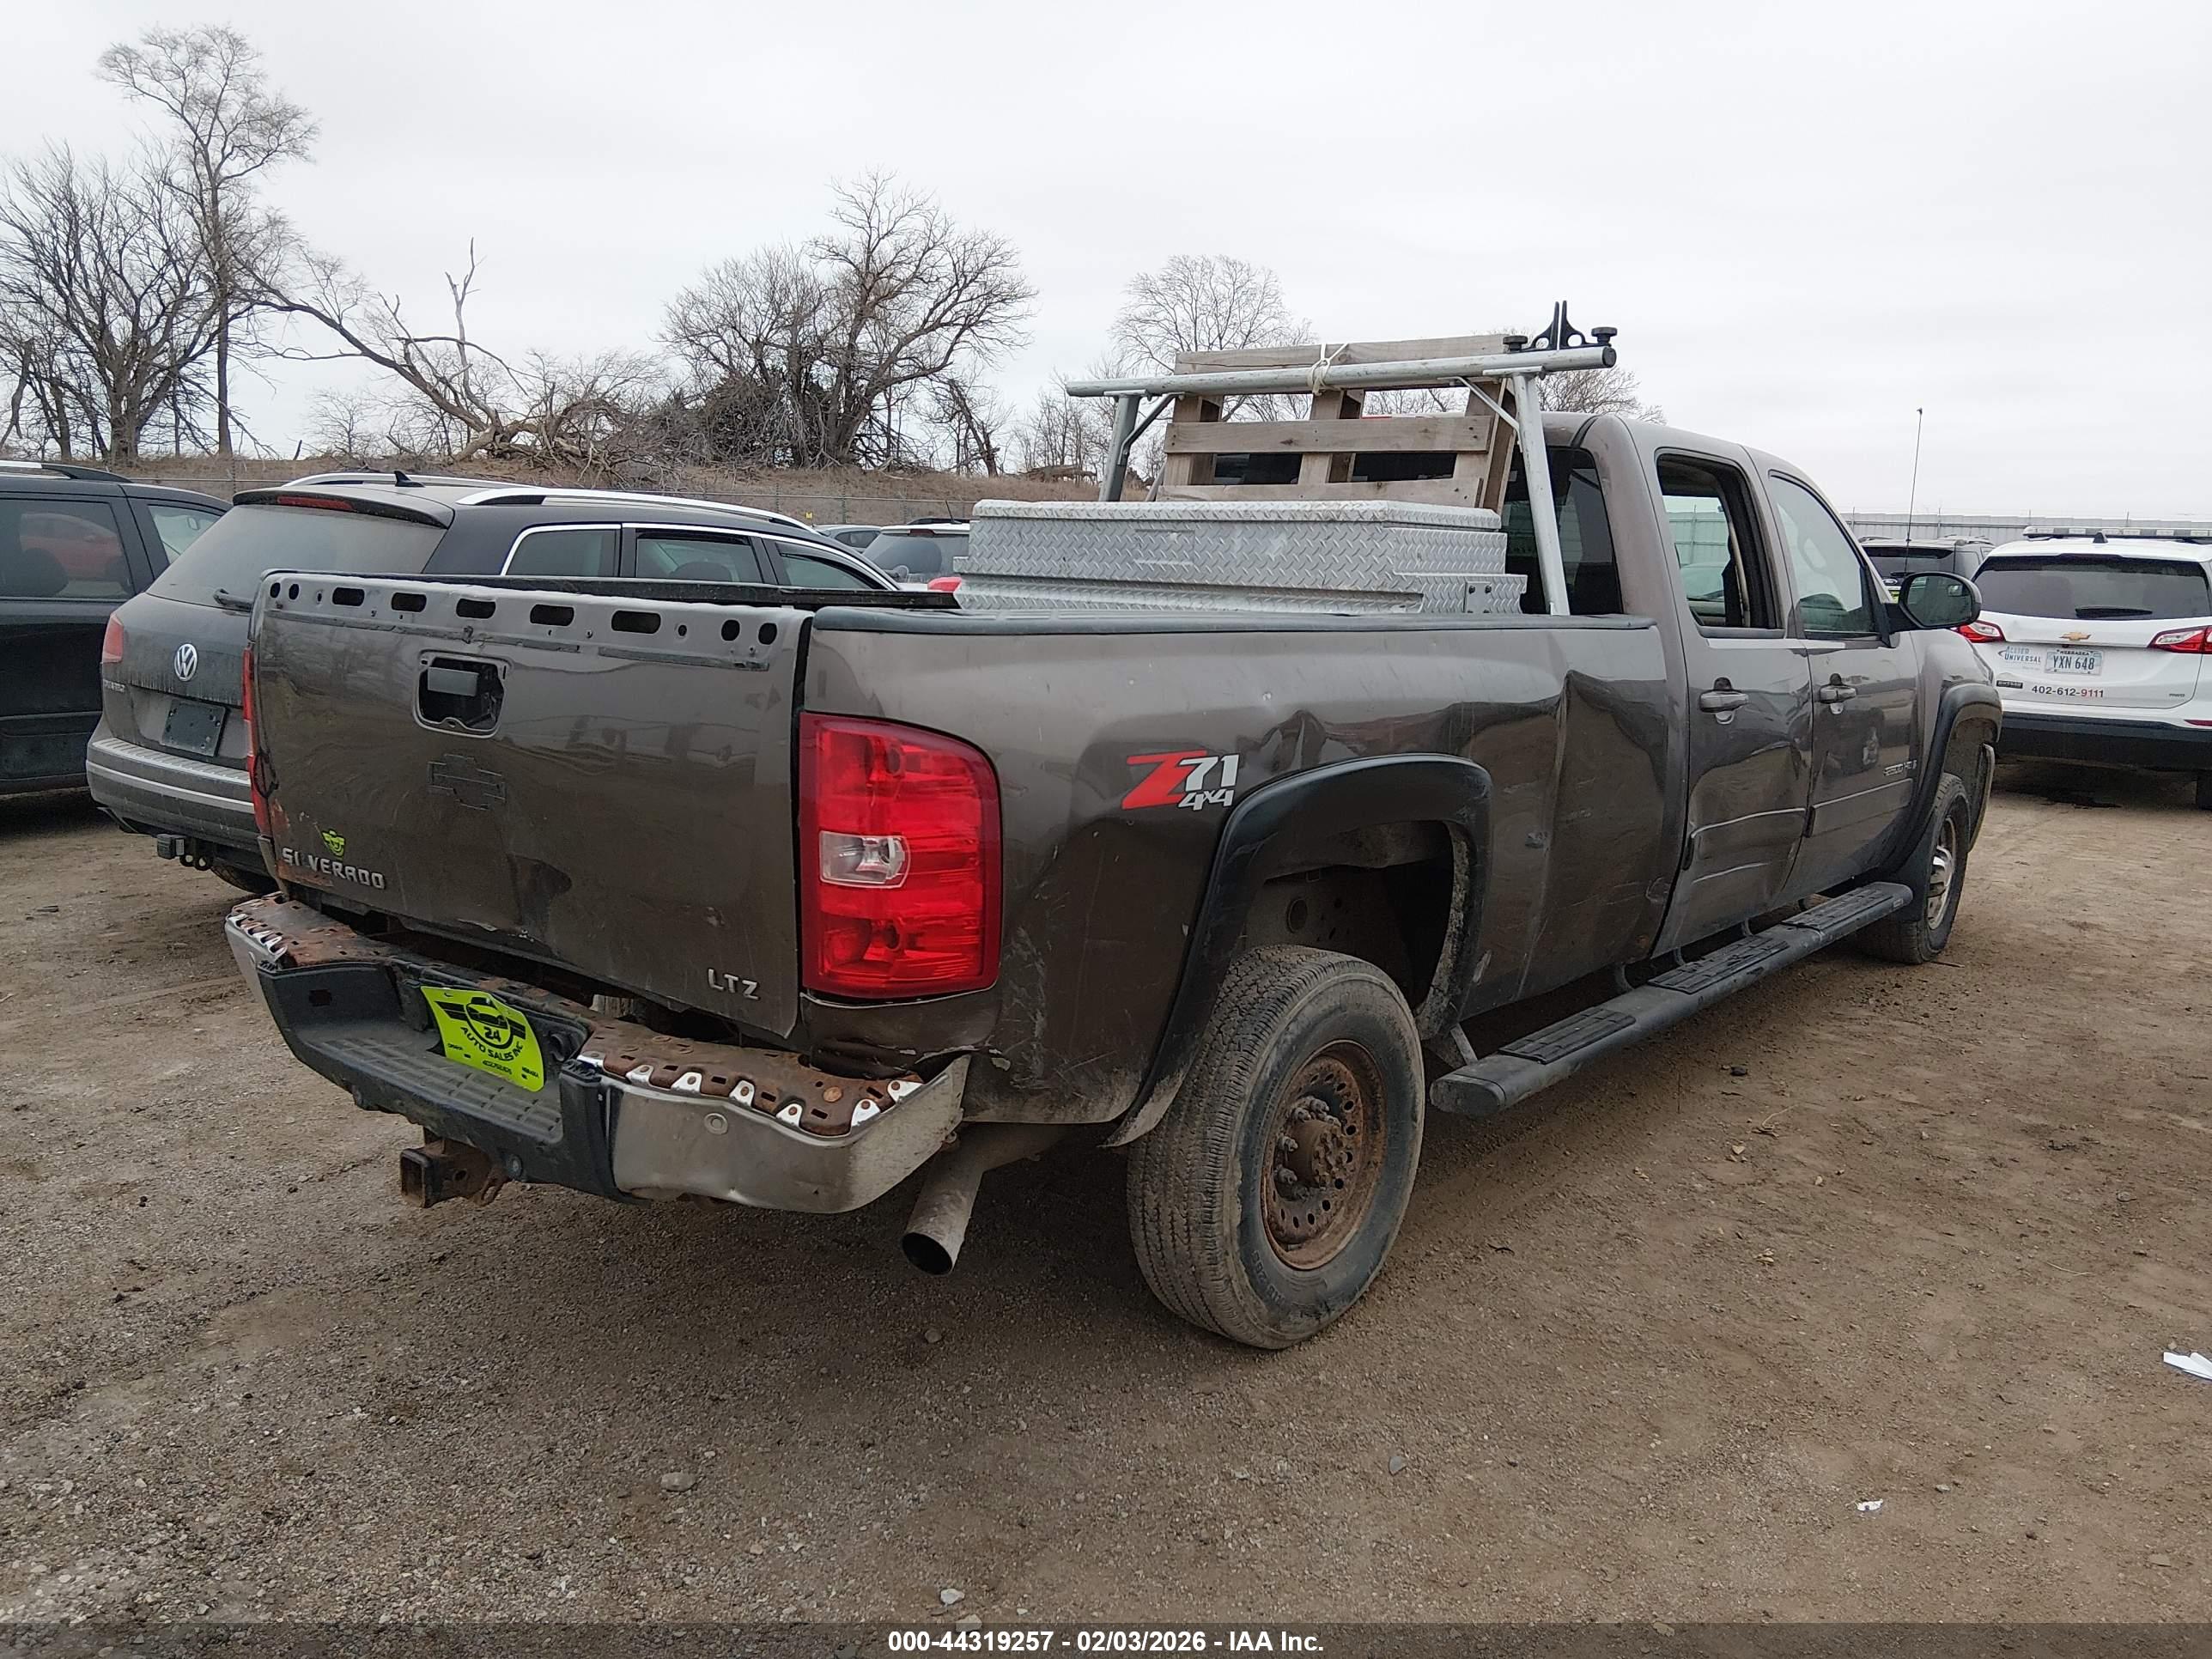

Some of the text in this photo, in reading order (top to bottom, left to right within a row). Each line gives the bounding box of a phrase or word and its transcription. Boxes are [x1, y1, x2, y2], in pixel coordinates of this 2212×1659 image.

[2004, 653, 2041, 663] UNIVERSAL
[2053, 655, 2095, 671] YXN 648
[2032, 685, 2104, 698] 402-612-9111
[1122, 749, 1239, 810] Z71
[282, 847, 386, 890] SIVERADO
[708, 969, 759, 1000] LTZ
[460, 1027, 486, 1053] AUTO
